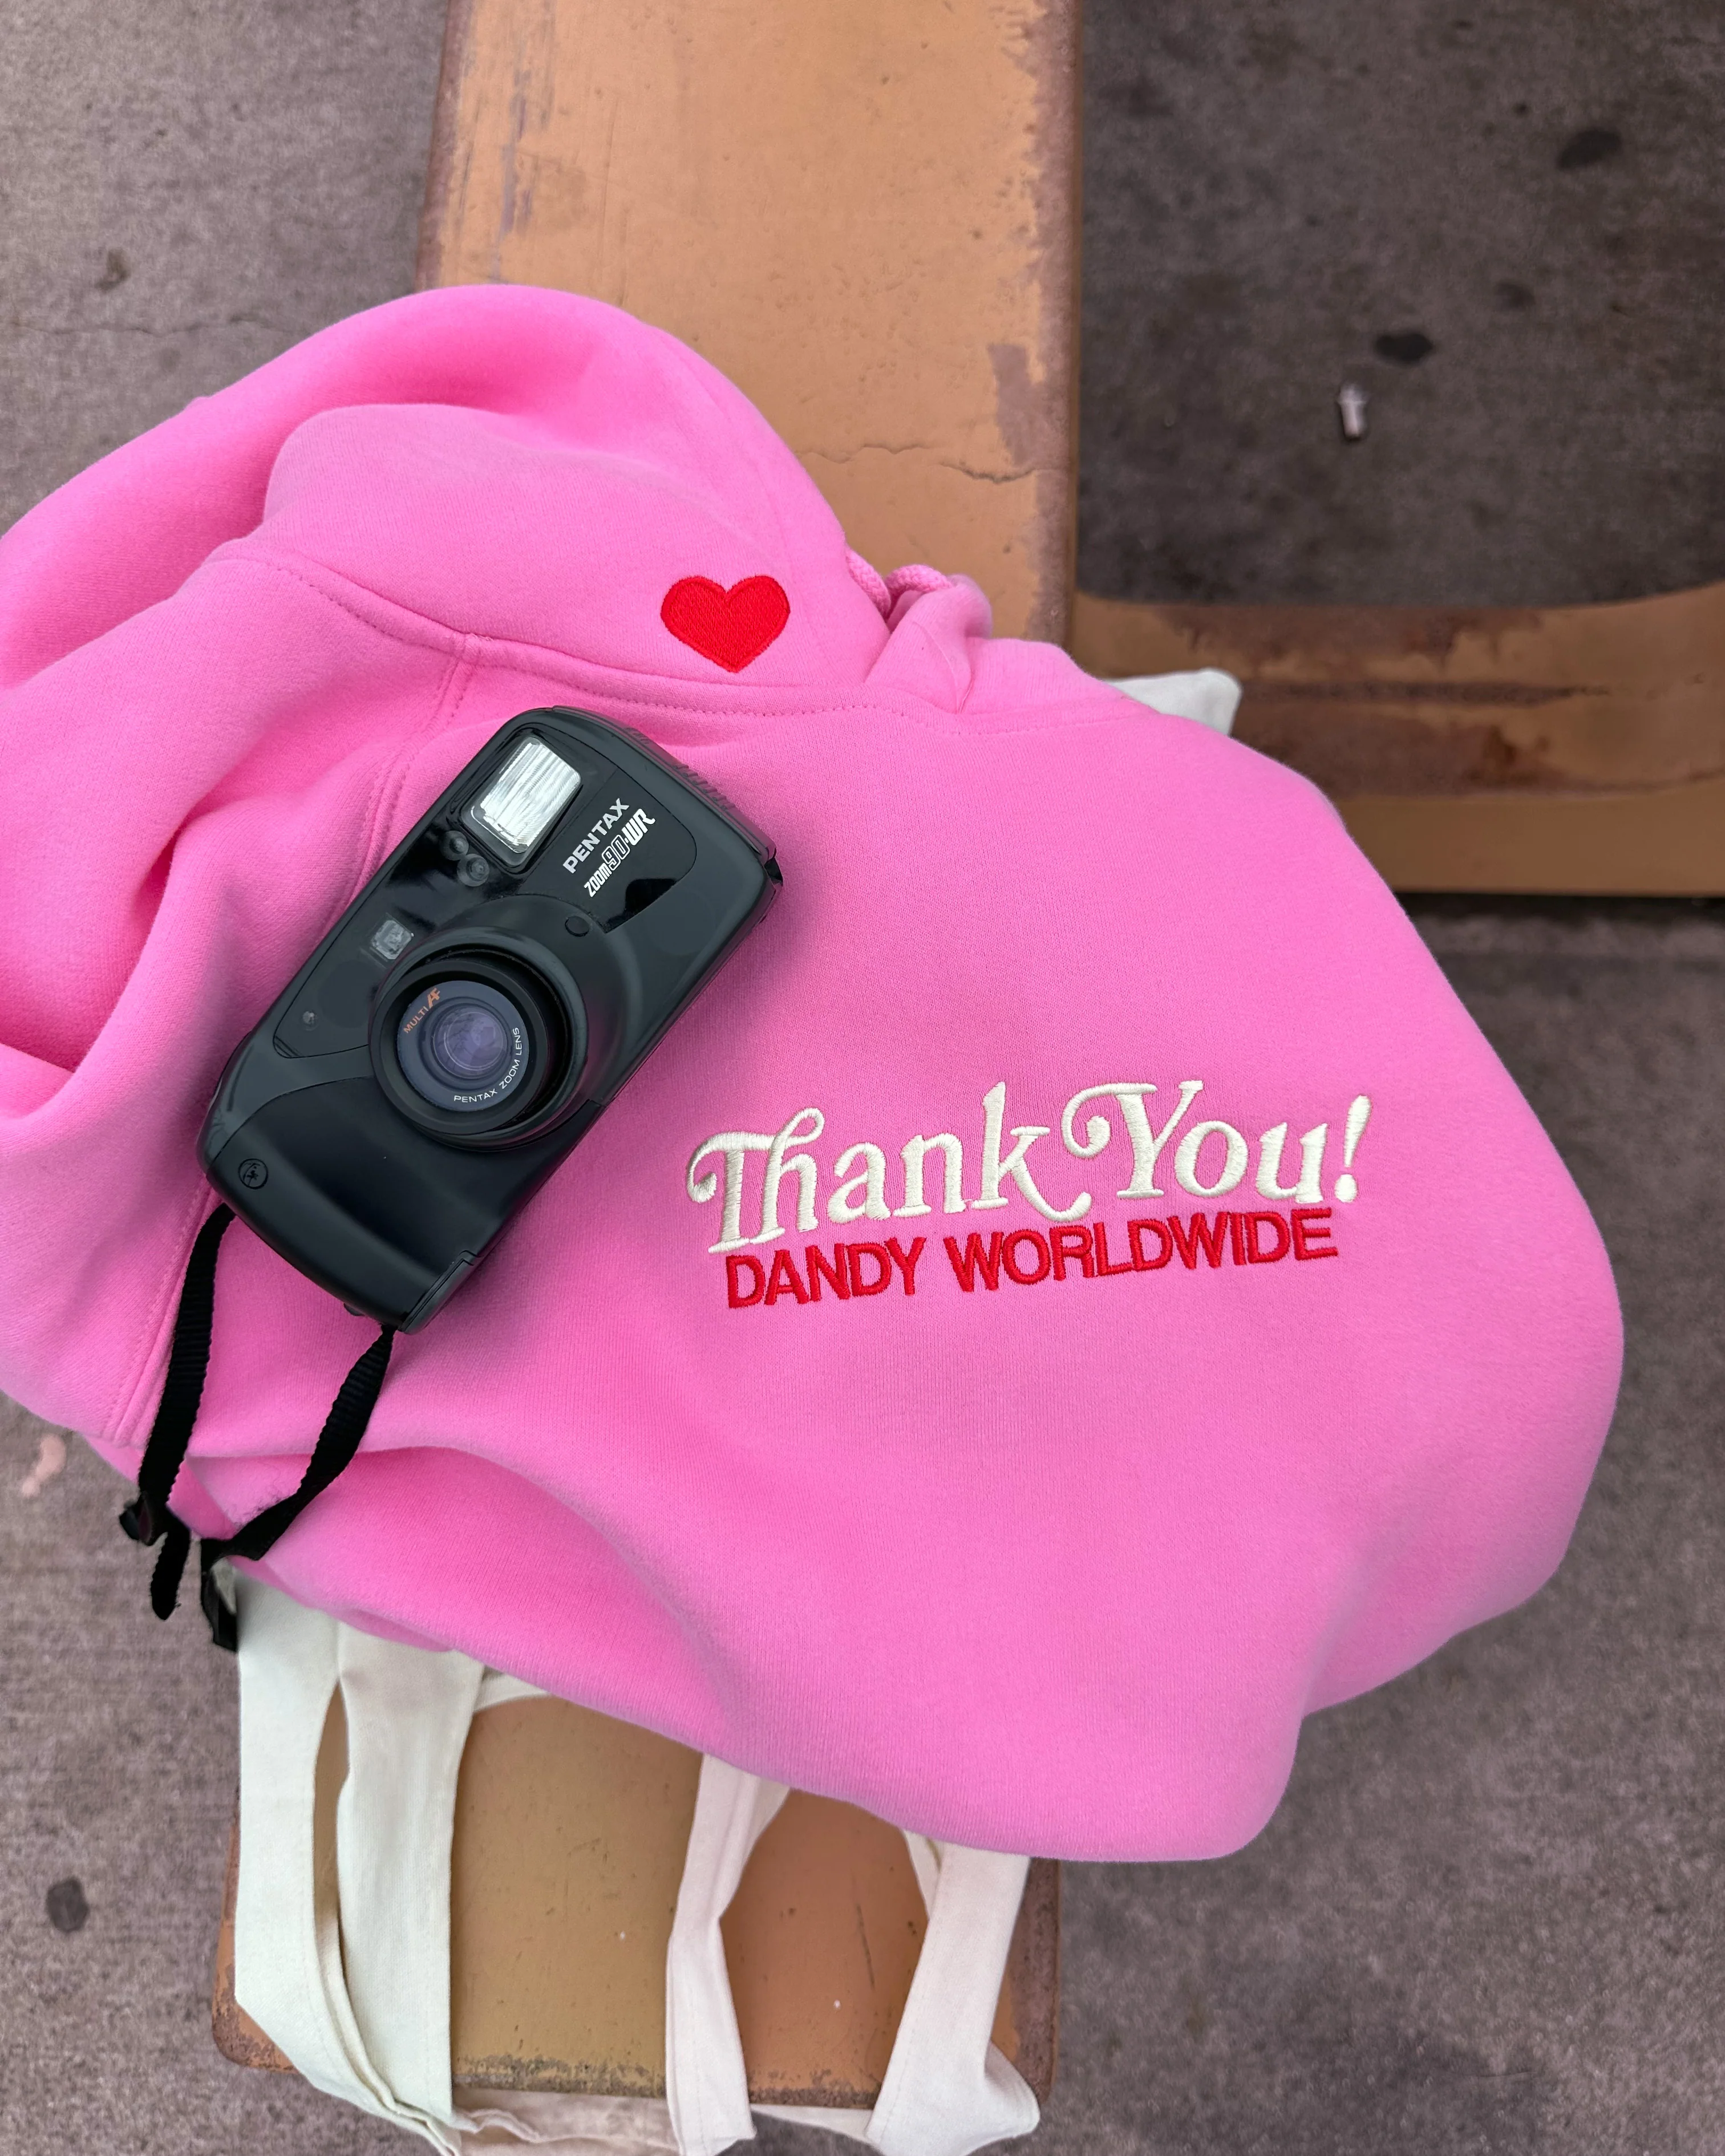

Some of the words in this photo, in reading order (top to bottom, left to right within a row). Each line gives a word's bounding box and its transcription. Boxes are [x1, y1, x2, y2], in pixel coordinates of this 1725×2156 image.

[562, 797, 630, 874] PENTAX
[403, 1006, 429, 1034] MULTI
[453, 1088, 497, 1103] PENTAX
[499, 1059, 520, 1089] ZOOM
[513, 1027, 522, 1055] LENS
[686, 1081, 1092, 1253] Thank
[1060, 1080, 1371, 1203] You!
[727, 1237, 926, 1308] DANDY
[943, 1207, 1338, 1292] WORLDWIDE
